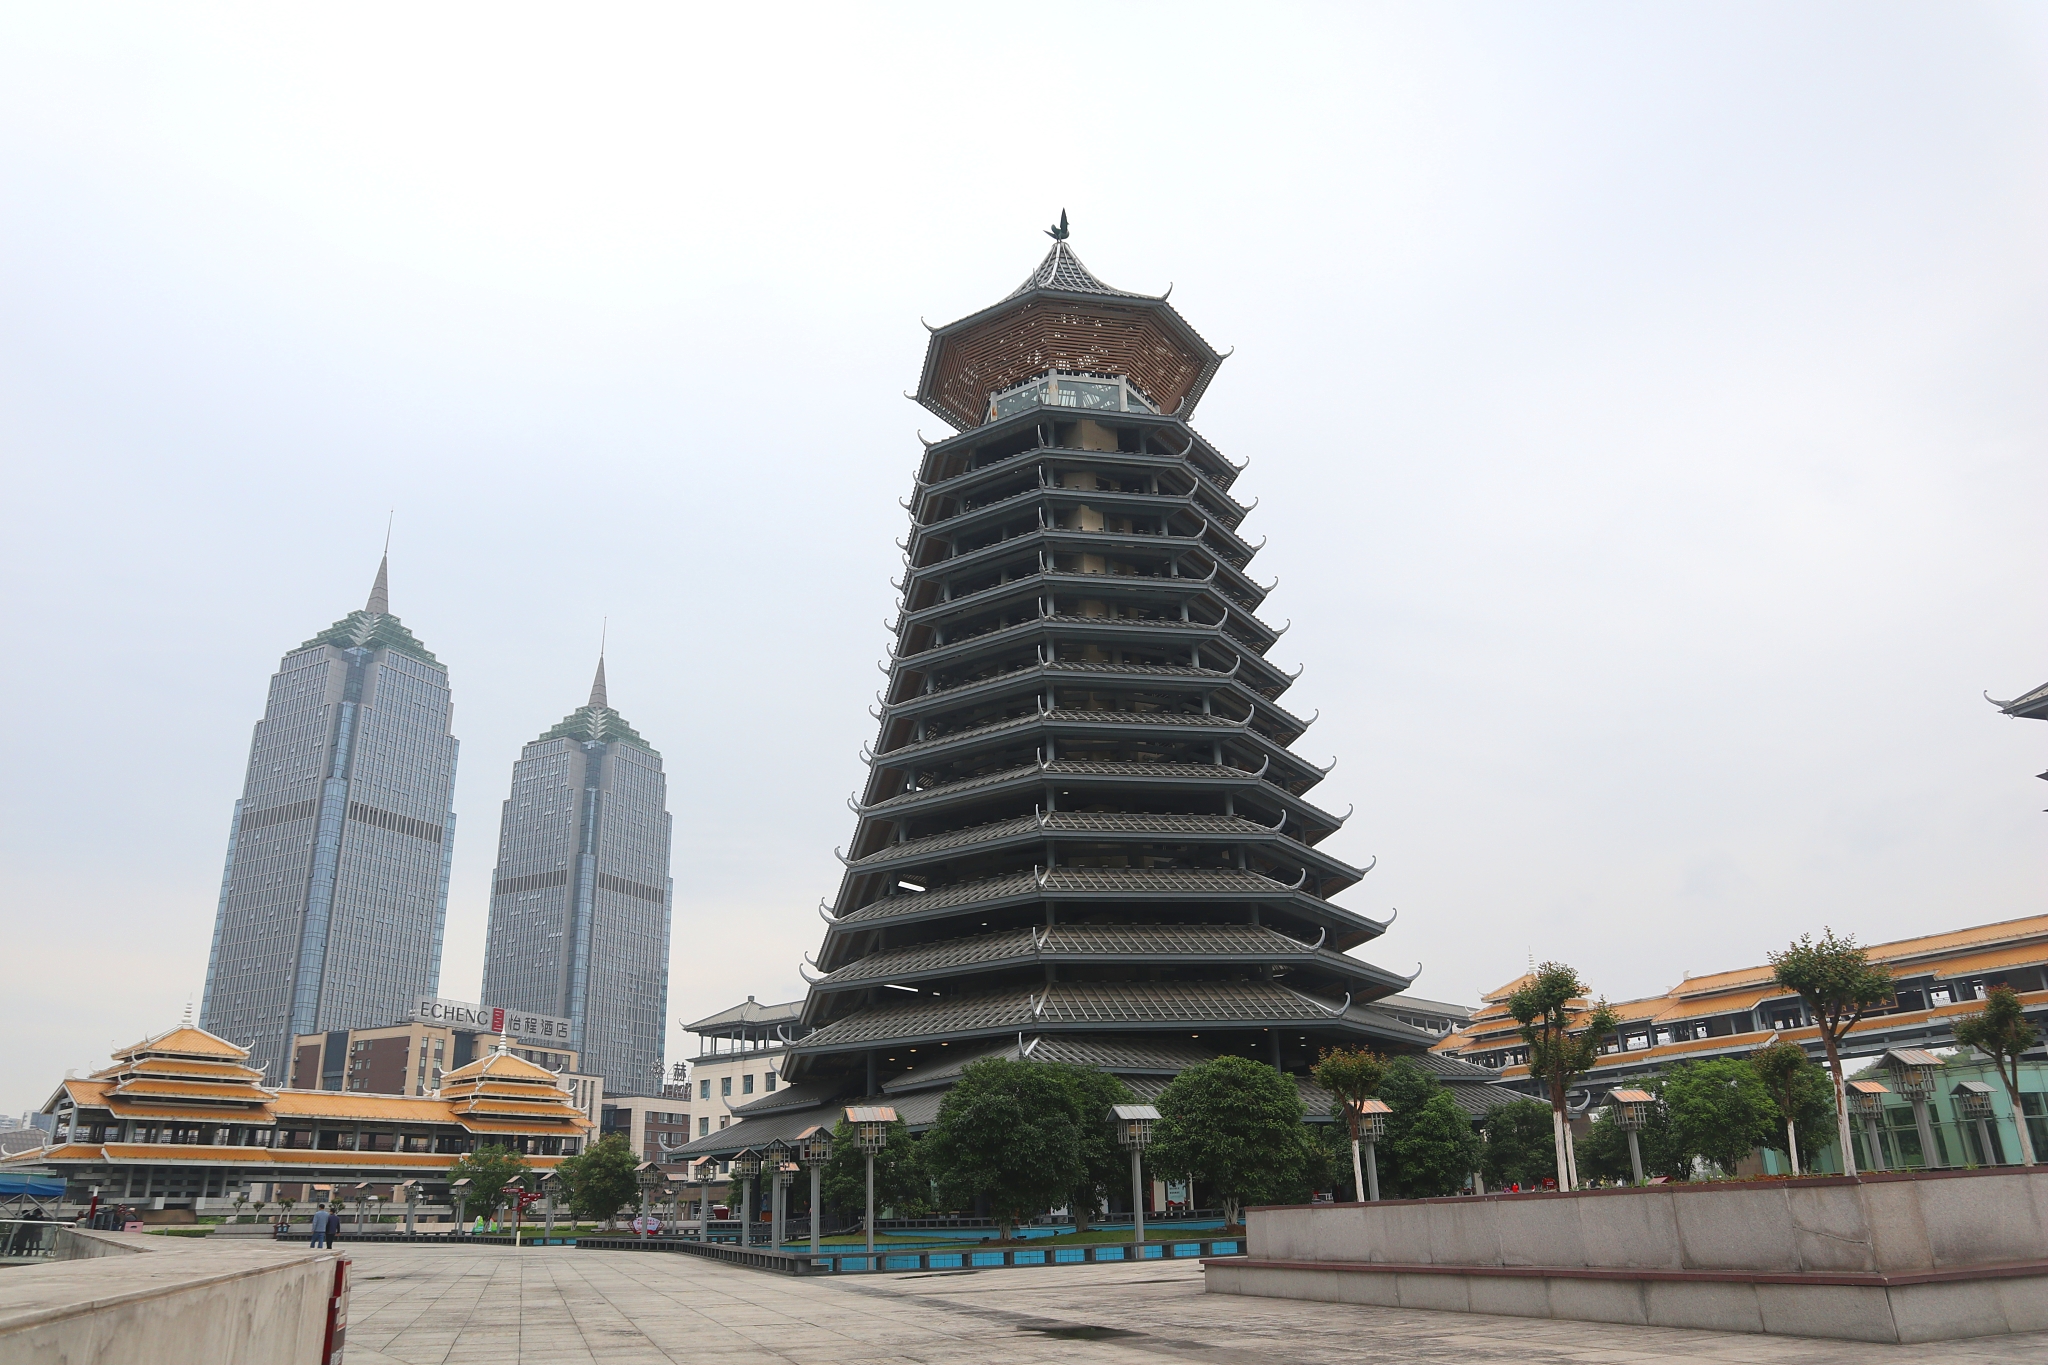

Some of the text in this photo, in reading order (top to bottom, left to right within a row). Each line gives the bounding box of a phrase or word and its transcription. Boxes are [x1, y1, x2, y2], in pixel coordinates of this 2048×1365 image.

[420, 1001, 488, 1025] ECHENG
[508, 1014, 568, 1038] 怡程酒店
